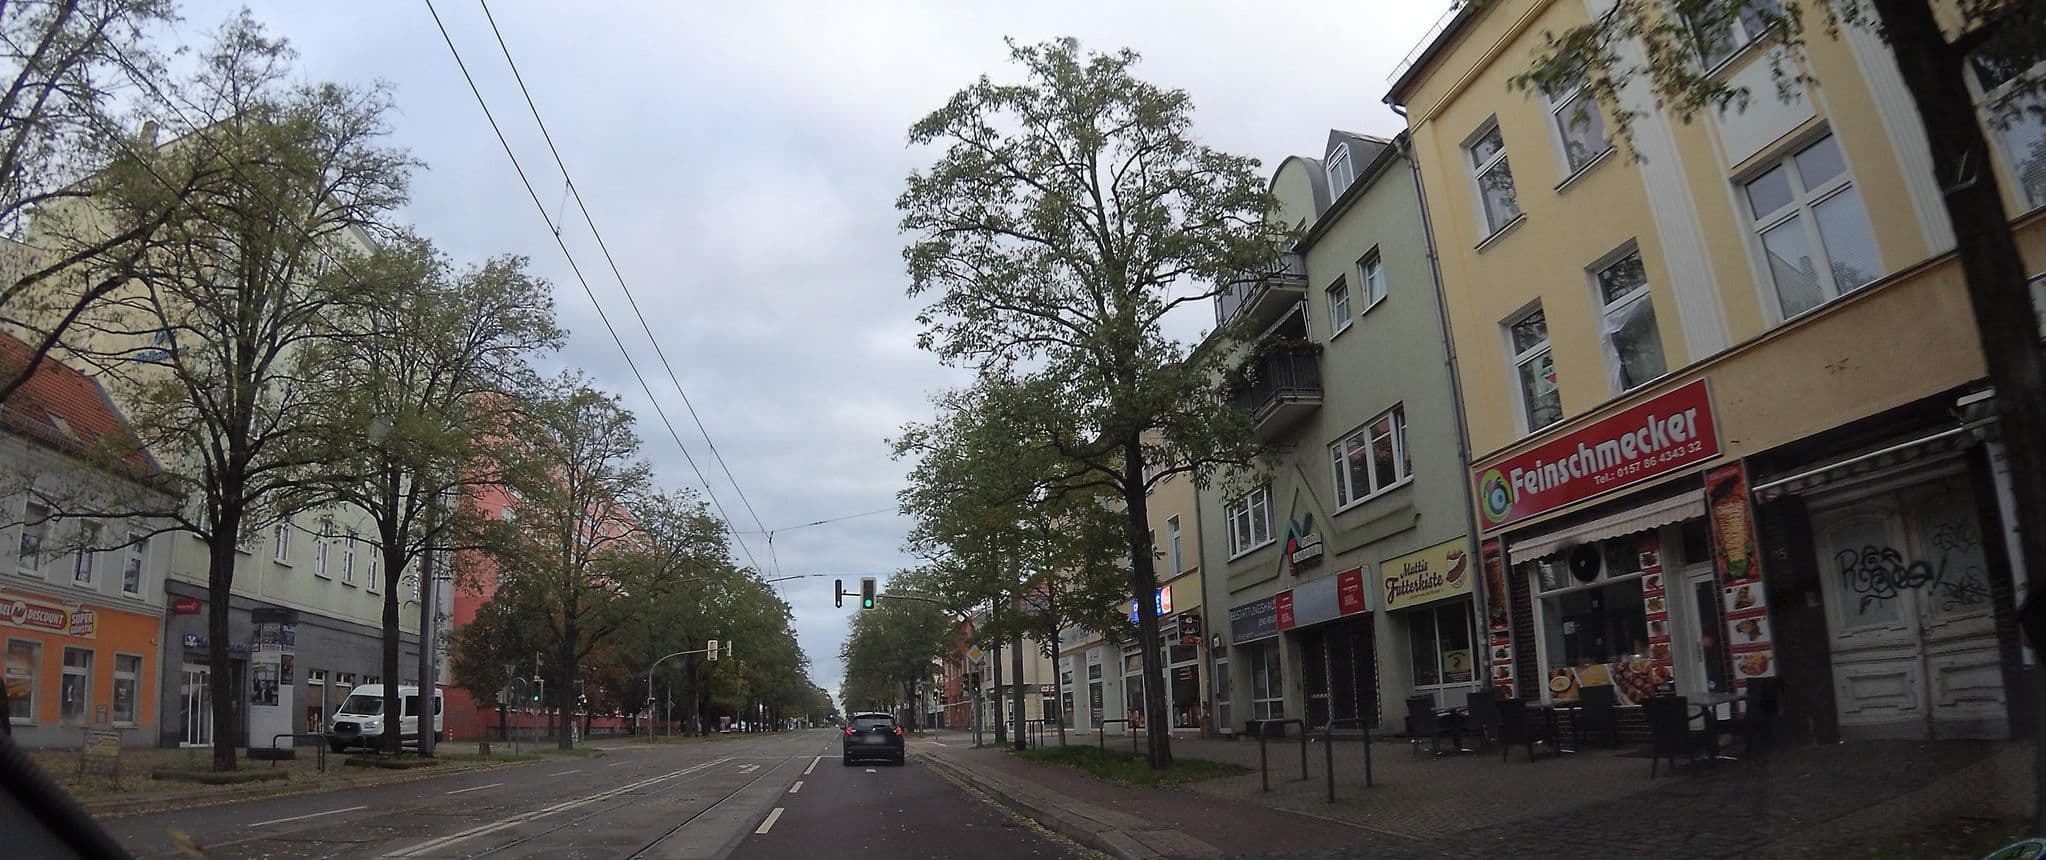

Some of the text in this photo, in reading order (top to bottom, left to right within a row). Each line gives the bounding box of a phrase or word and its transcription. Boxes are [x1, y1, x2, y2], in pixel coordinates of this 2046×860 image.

[1510, 407, 1697, 505] Feinschmecker
[1593, 440, 1702, 486] Tel.: 0157 86 4343 32
[1400, 559, 1429, 579] Mattis
[1385, 570, 1445, 604] Futterkiste
[27, 608, 64, 625] DISCOUNT
[71, 612, 94, 625] SUPER
